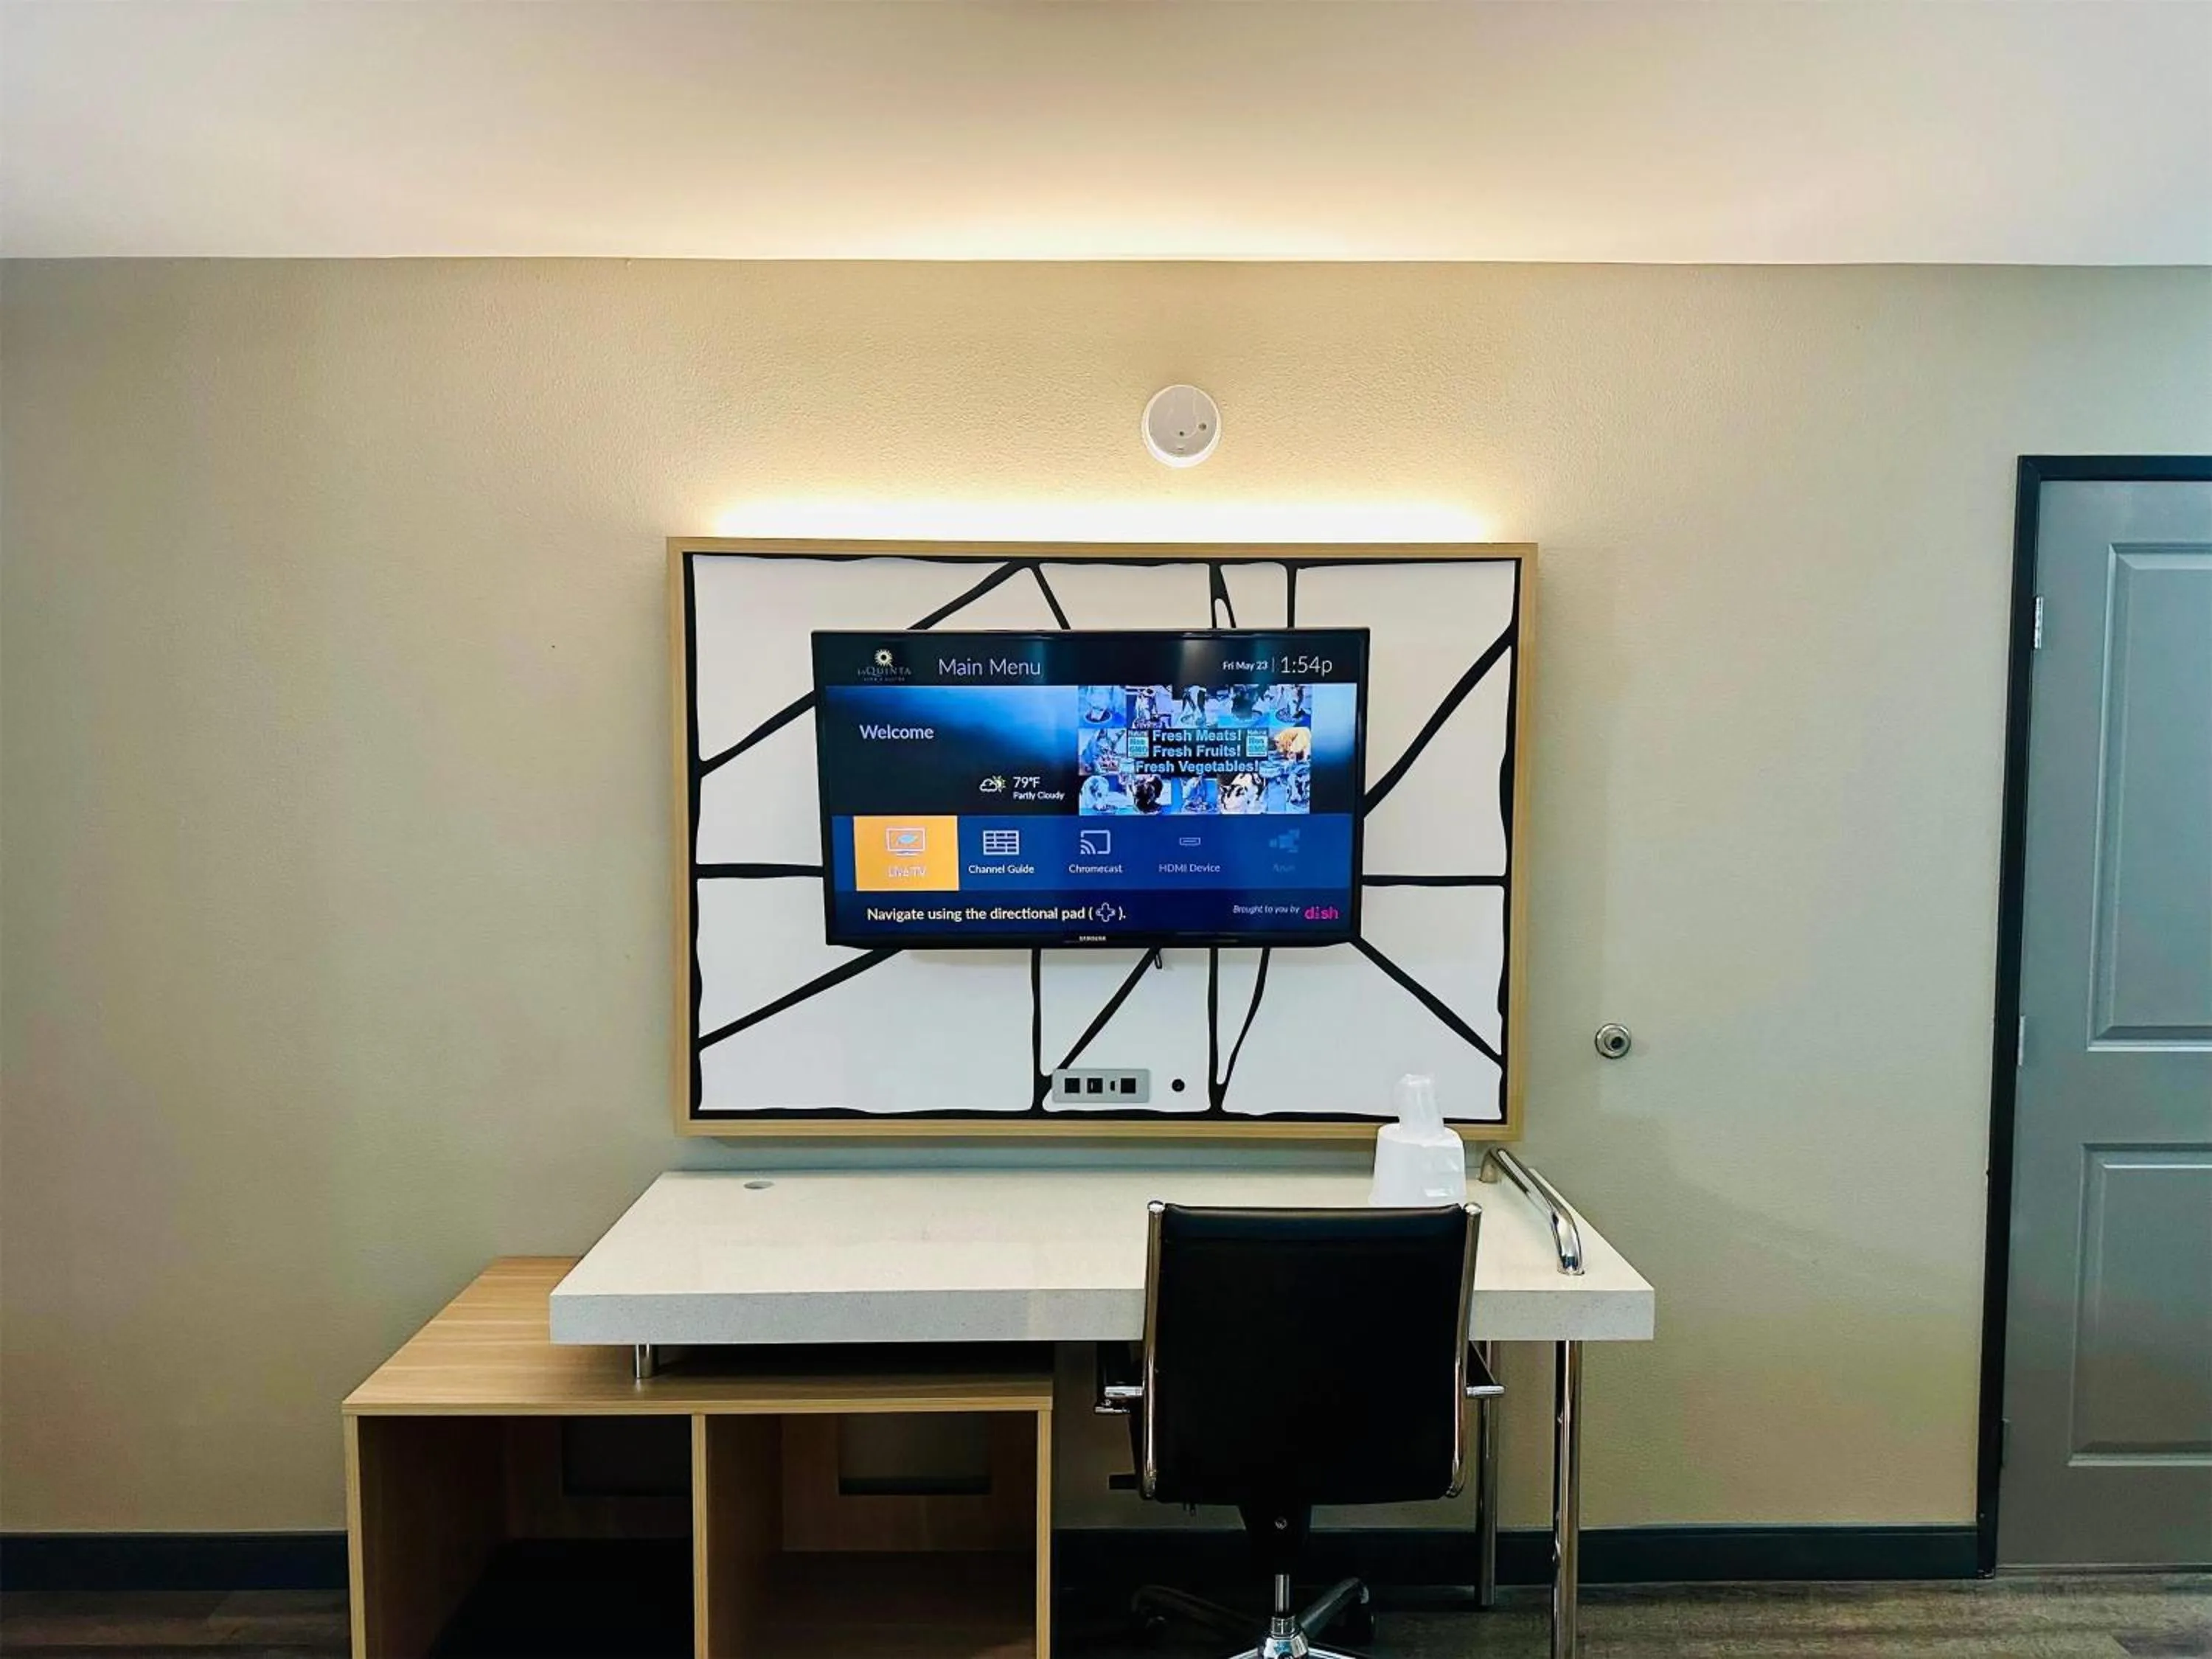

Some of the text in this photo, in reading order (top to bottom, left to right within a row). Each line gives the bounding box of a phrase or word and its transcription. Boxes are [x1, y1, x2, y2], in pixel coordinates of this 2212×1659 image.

[939, 658, 1041, 676] Main Menu
[1222, 661, 1267, 672] Fri May 23
[1281, 655, 1332, 677] 1:54p
[860, 724, 934, 739] Welcome
[1152, 729, 1192, 742] Fresh
[1196, 729, 1242, 742] Meats!
[1152, 745, 1192, 757] Fresh
[1196, 744, 1241, 757] Fruits!
[1135, 759, 1259, 776] Fresh Vegetables!
[1013, 791, 1065, 801] Partly Cloudy
[968, 864, 1034, 874] Channel Guide
[1068, 863, 1122, 873] Chromecast
[1158, 863, 1220, 872] HDMI Device
[867, 908, 924, 922] Navigate
[929, 909, 961, 922] using
[966, 908, 986, 919] the
[990, 907, 1057, 919] directional
[1062, 907, 1085, 922] pad
[1233, 905, 1263, 914] Brought
[1290, 905, 1300, 914] by
[1304, 906, 1338, 920] dish
